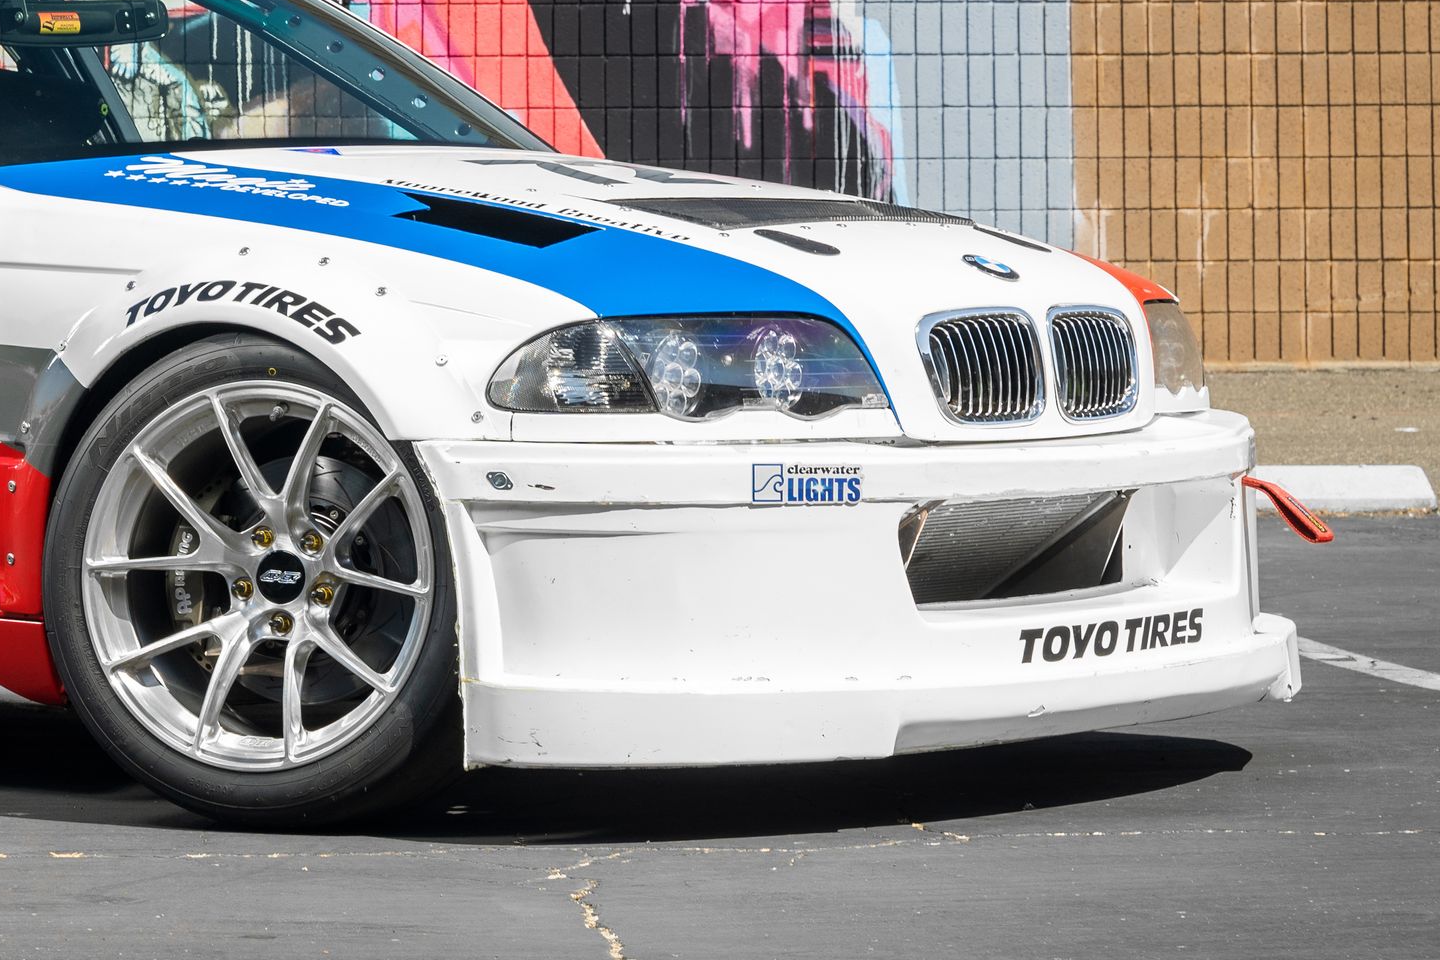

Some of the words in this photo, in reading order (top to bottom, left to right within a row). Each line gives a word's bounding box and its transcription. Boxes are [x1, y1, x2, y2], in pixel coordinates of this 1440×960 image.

[219, 185, 350, 207] DEVELOPED
[126, 280, 227, 328] TOYO
[231, 282, 361, 344] TIRES
[787, 465, 860, 474] clearwater
[788, 478, 861, 502] LIGHTS
[1019, 621, 1119, 664] TOYO
[1124, 608, 1203, 653] TIRES
